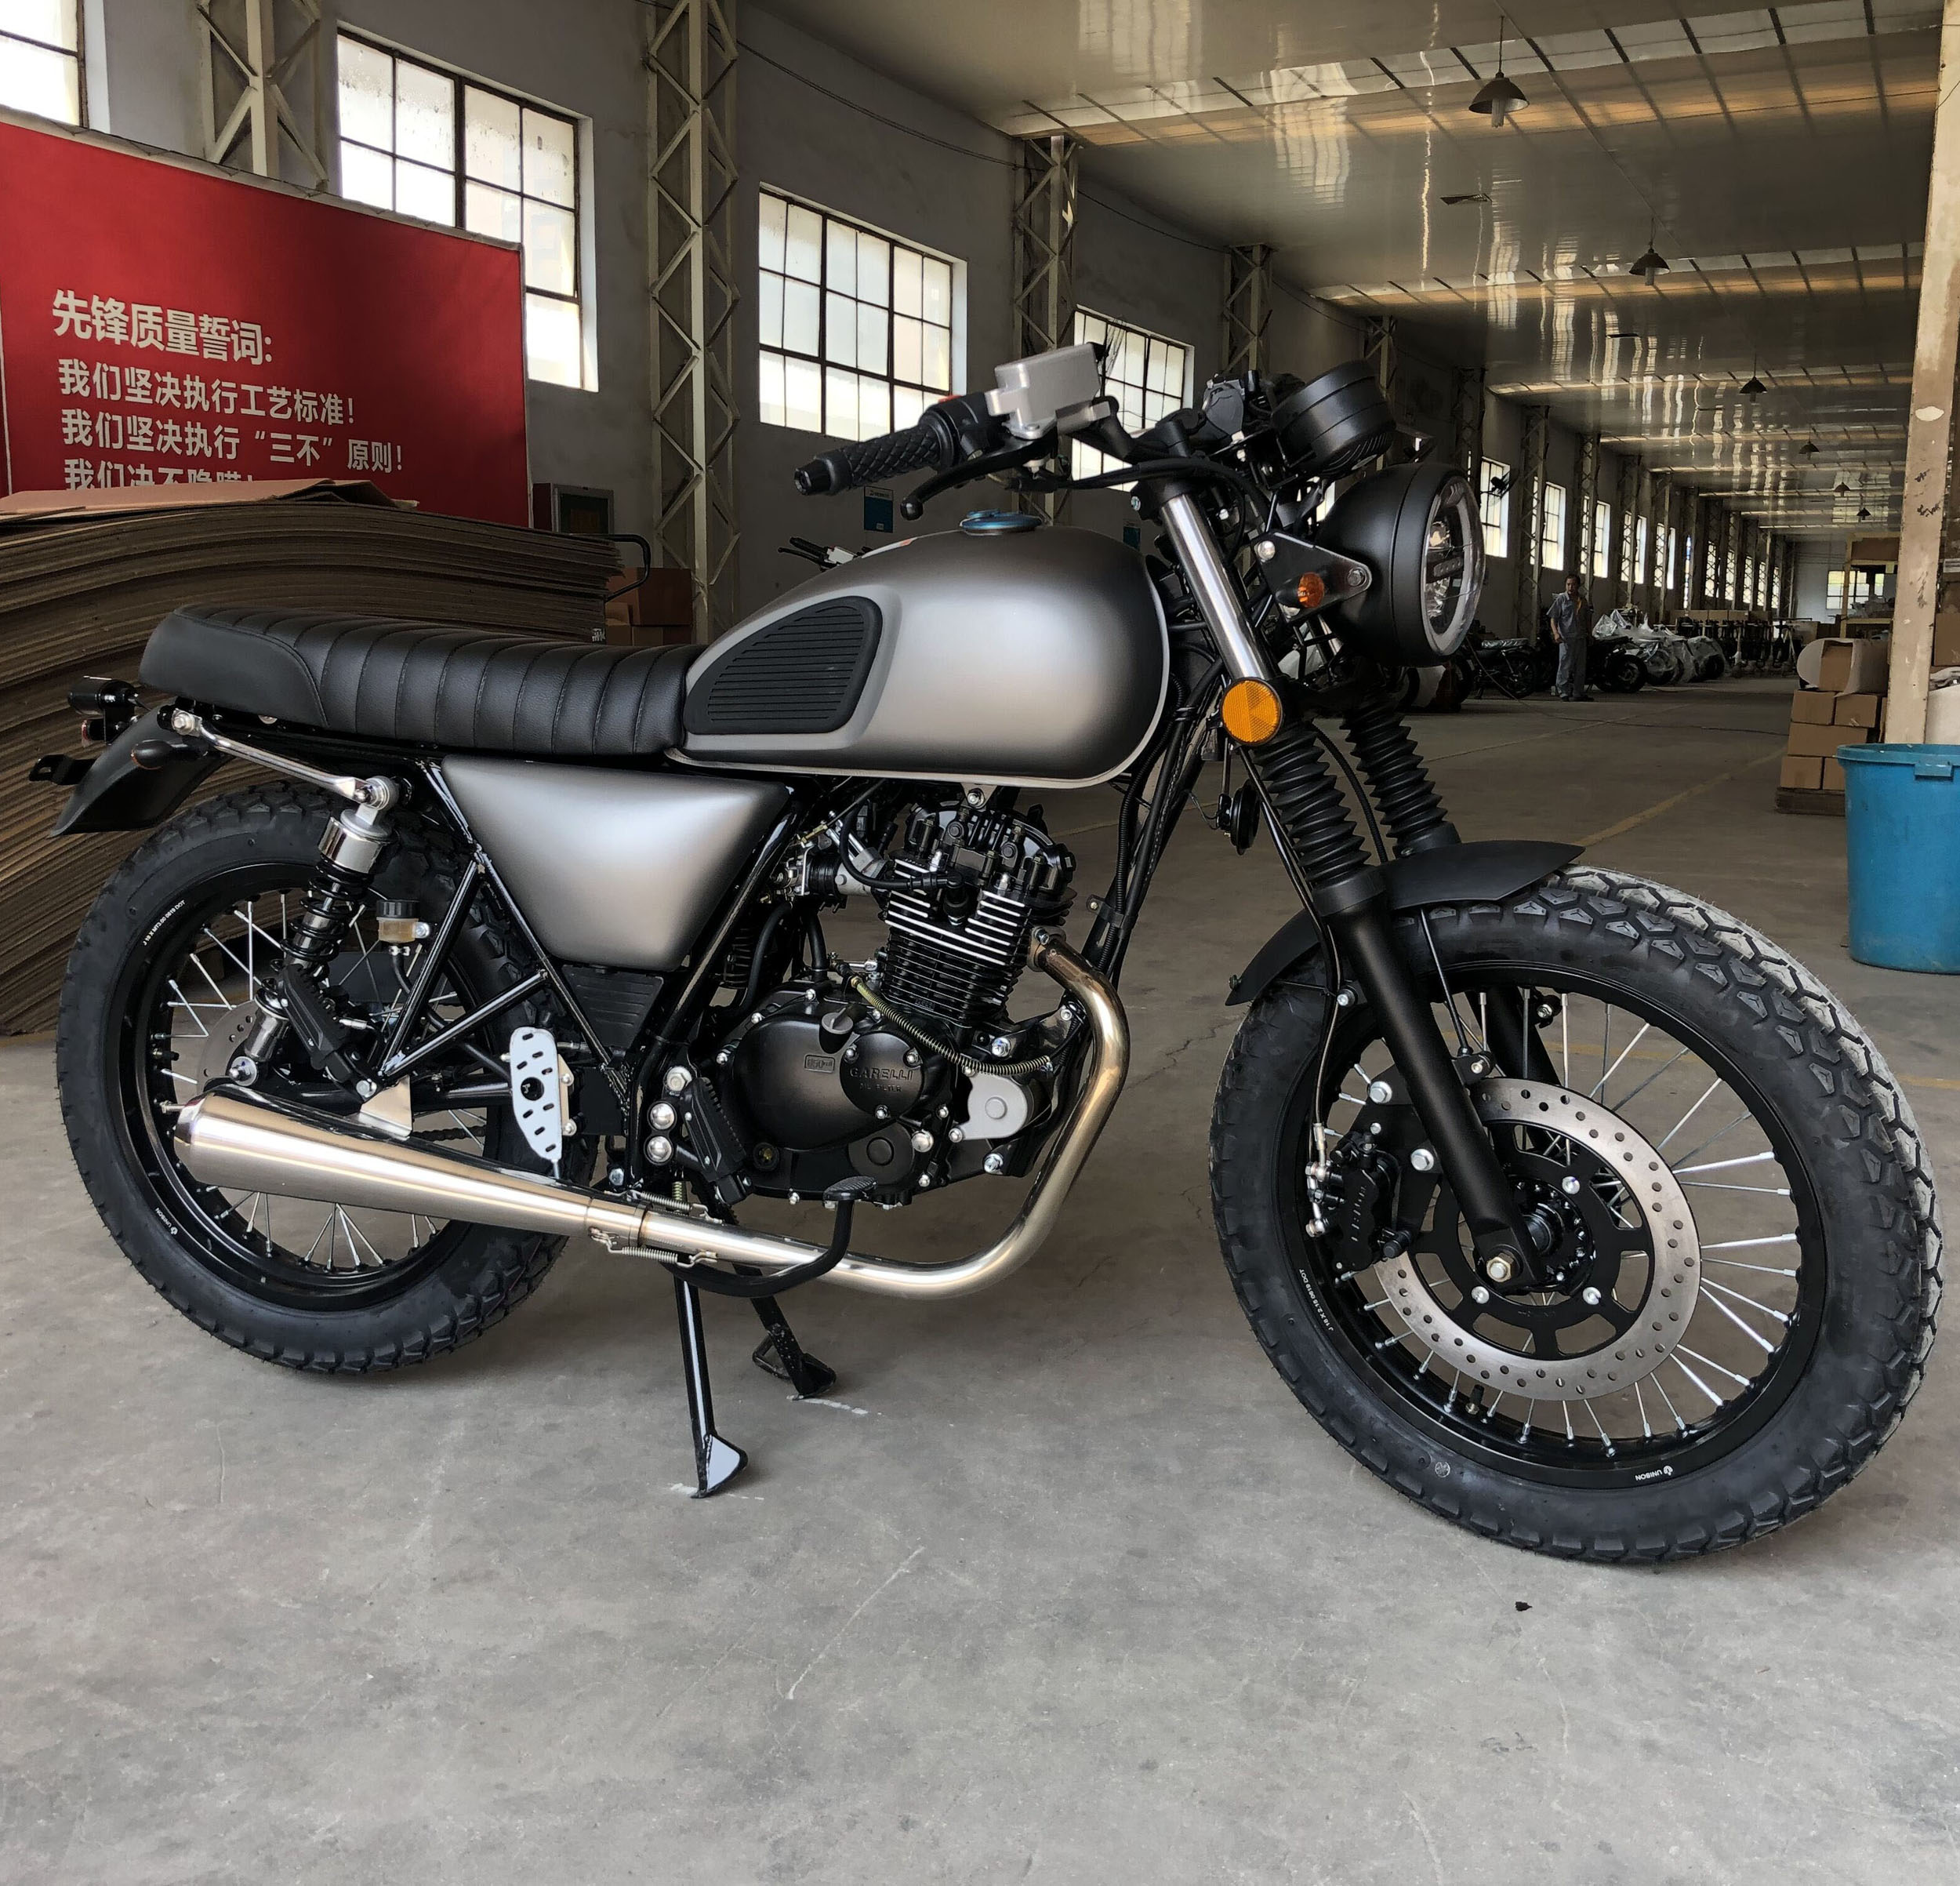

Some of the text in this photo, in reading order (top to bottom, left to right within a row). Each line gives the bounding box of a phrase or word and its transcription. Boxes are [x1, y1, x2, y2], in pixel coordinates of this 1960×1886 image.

[53, 289, 272, 365] 先锋质量誓词:
[58, 358, 354, 425] 我们坚决执行工艺标准!
[174, 899, 185, 910] DOT
[850, 1067, 913, 1081] GARELLI
[876, 1084, 902, 1092] FILTER
[1299, 1269, 1308, 1283] DOT
[1635, 1470, 1662, 1481] UNISON
